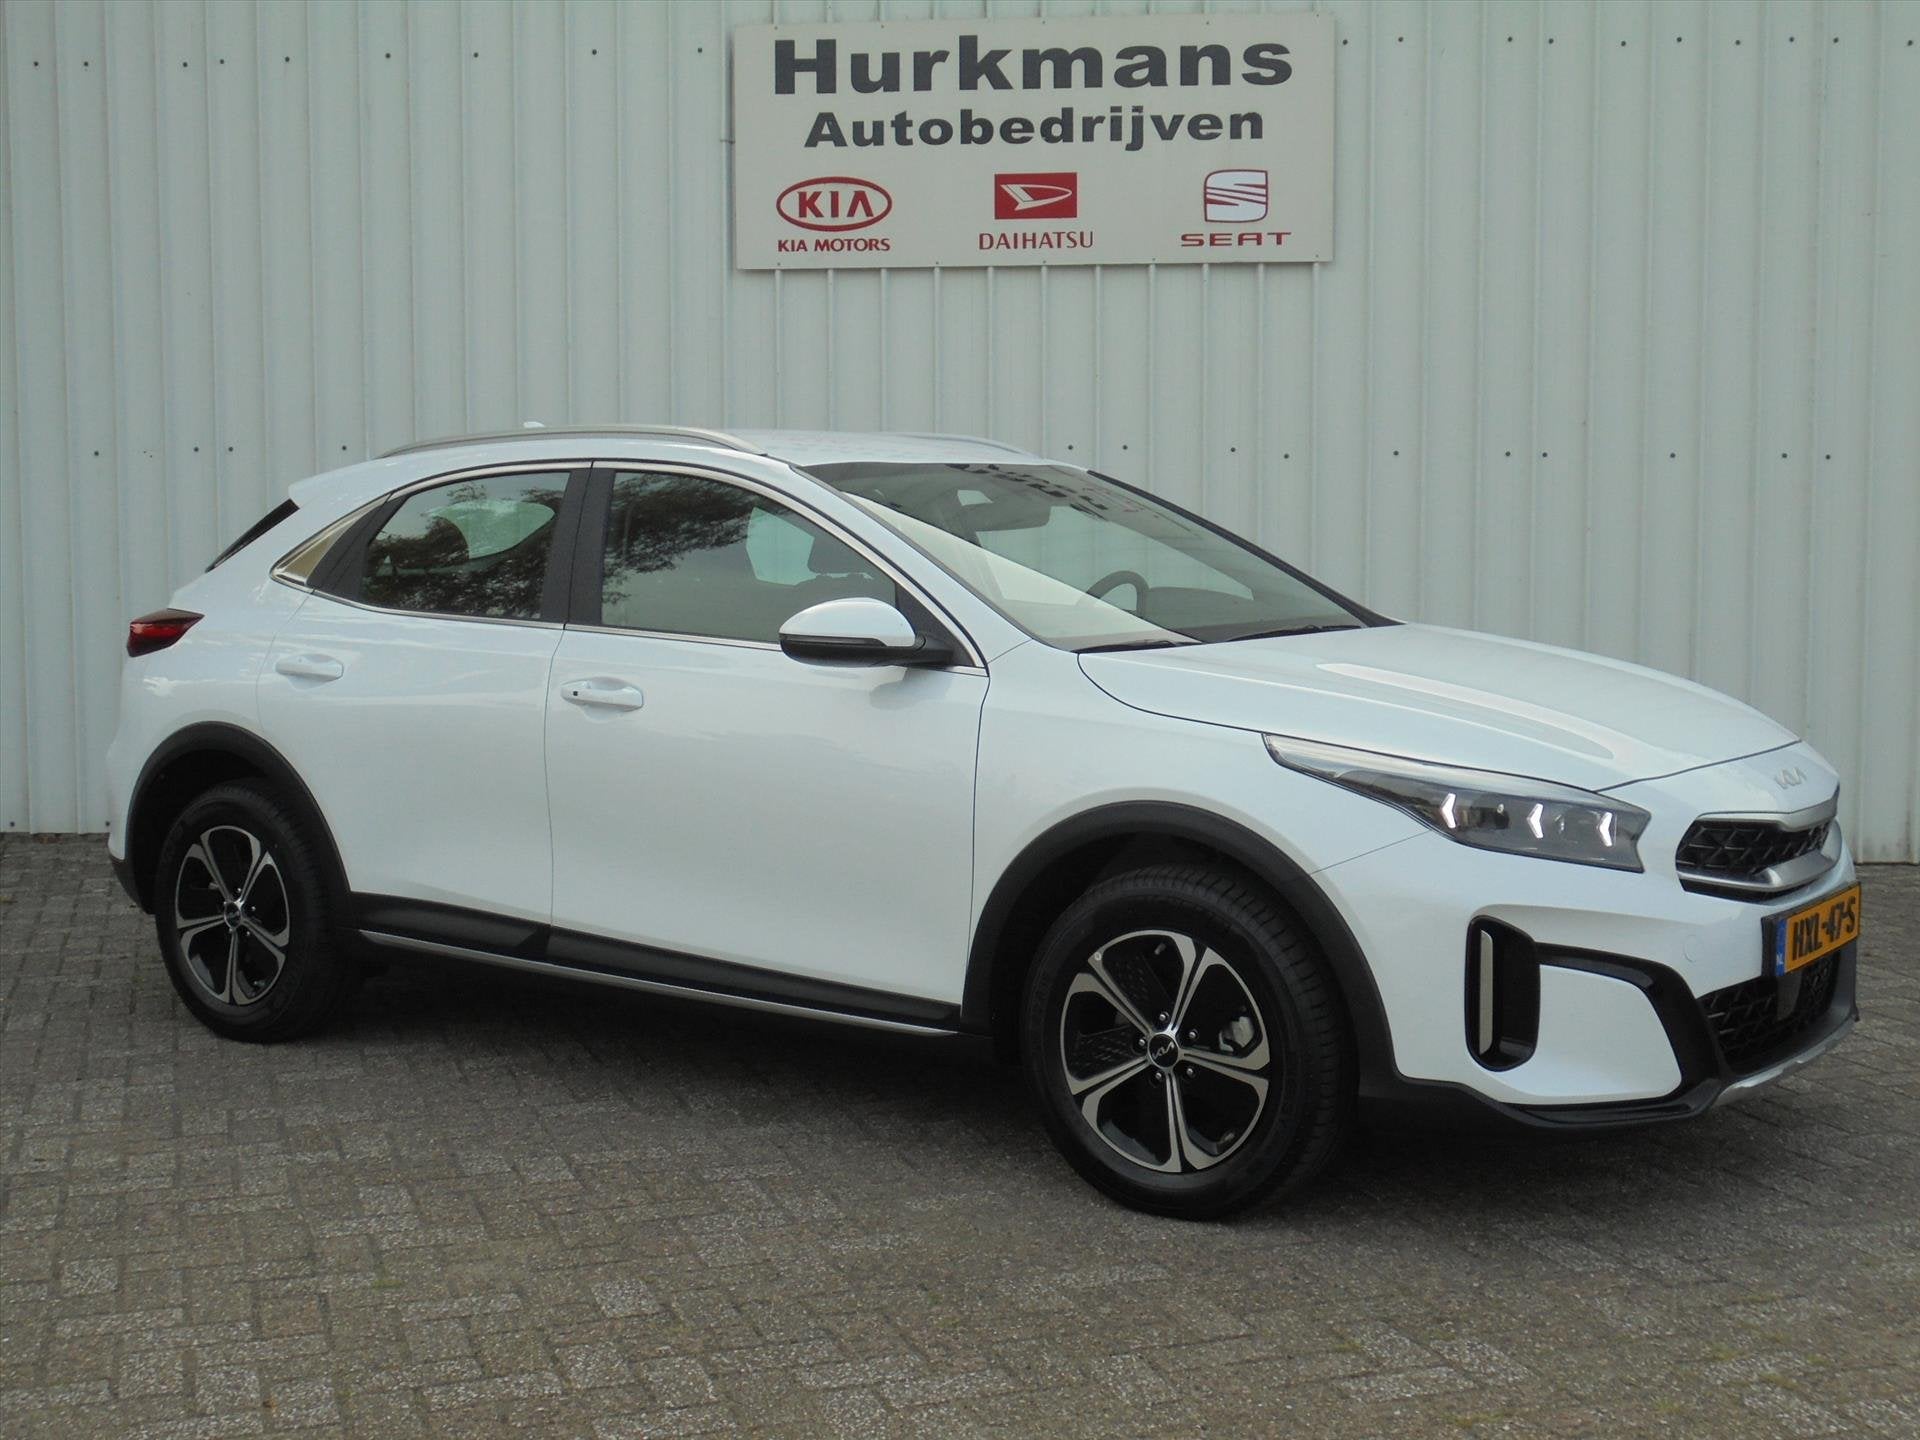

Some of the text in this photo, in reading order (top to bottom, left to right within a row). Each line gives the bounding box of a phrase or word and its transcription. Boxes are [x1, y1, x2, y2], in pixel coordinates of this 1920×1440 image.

[774, 35, 1293, 94] Hurkmans
[804, 105, 1263, 151] Autobedrijven
[797, 190, 874, 218] KIA
[778, 238, 891, 252] KIA MOTORS
[979, 231, 1094, 250] DAIHATSU
[1181, 232, 1291, 247] SEAT
